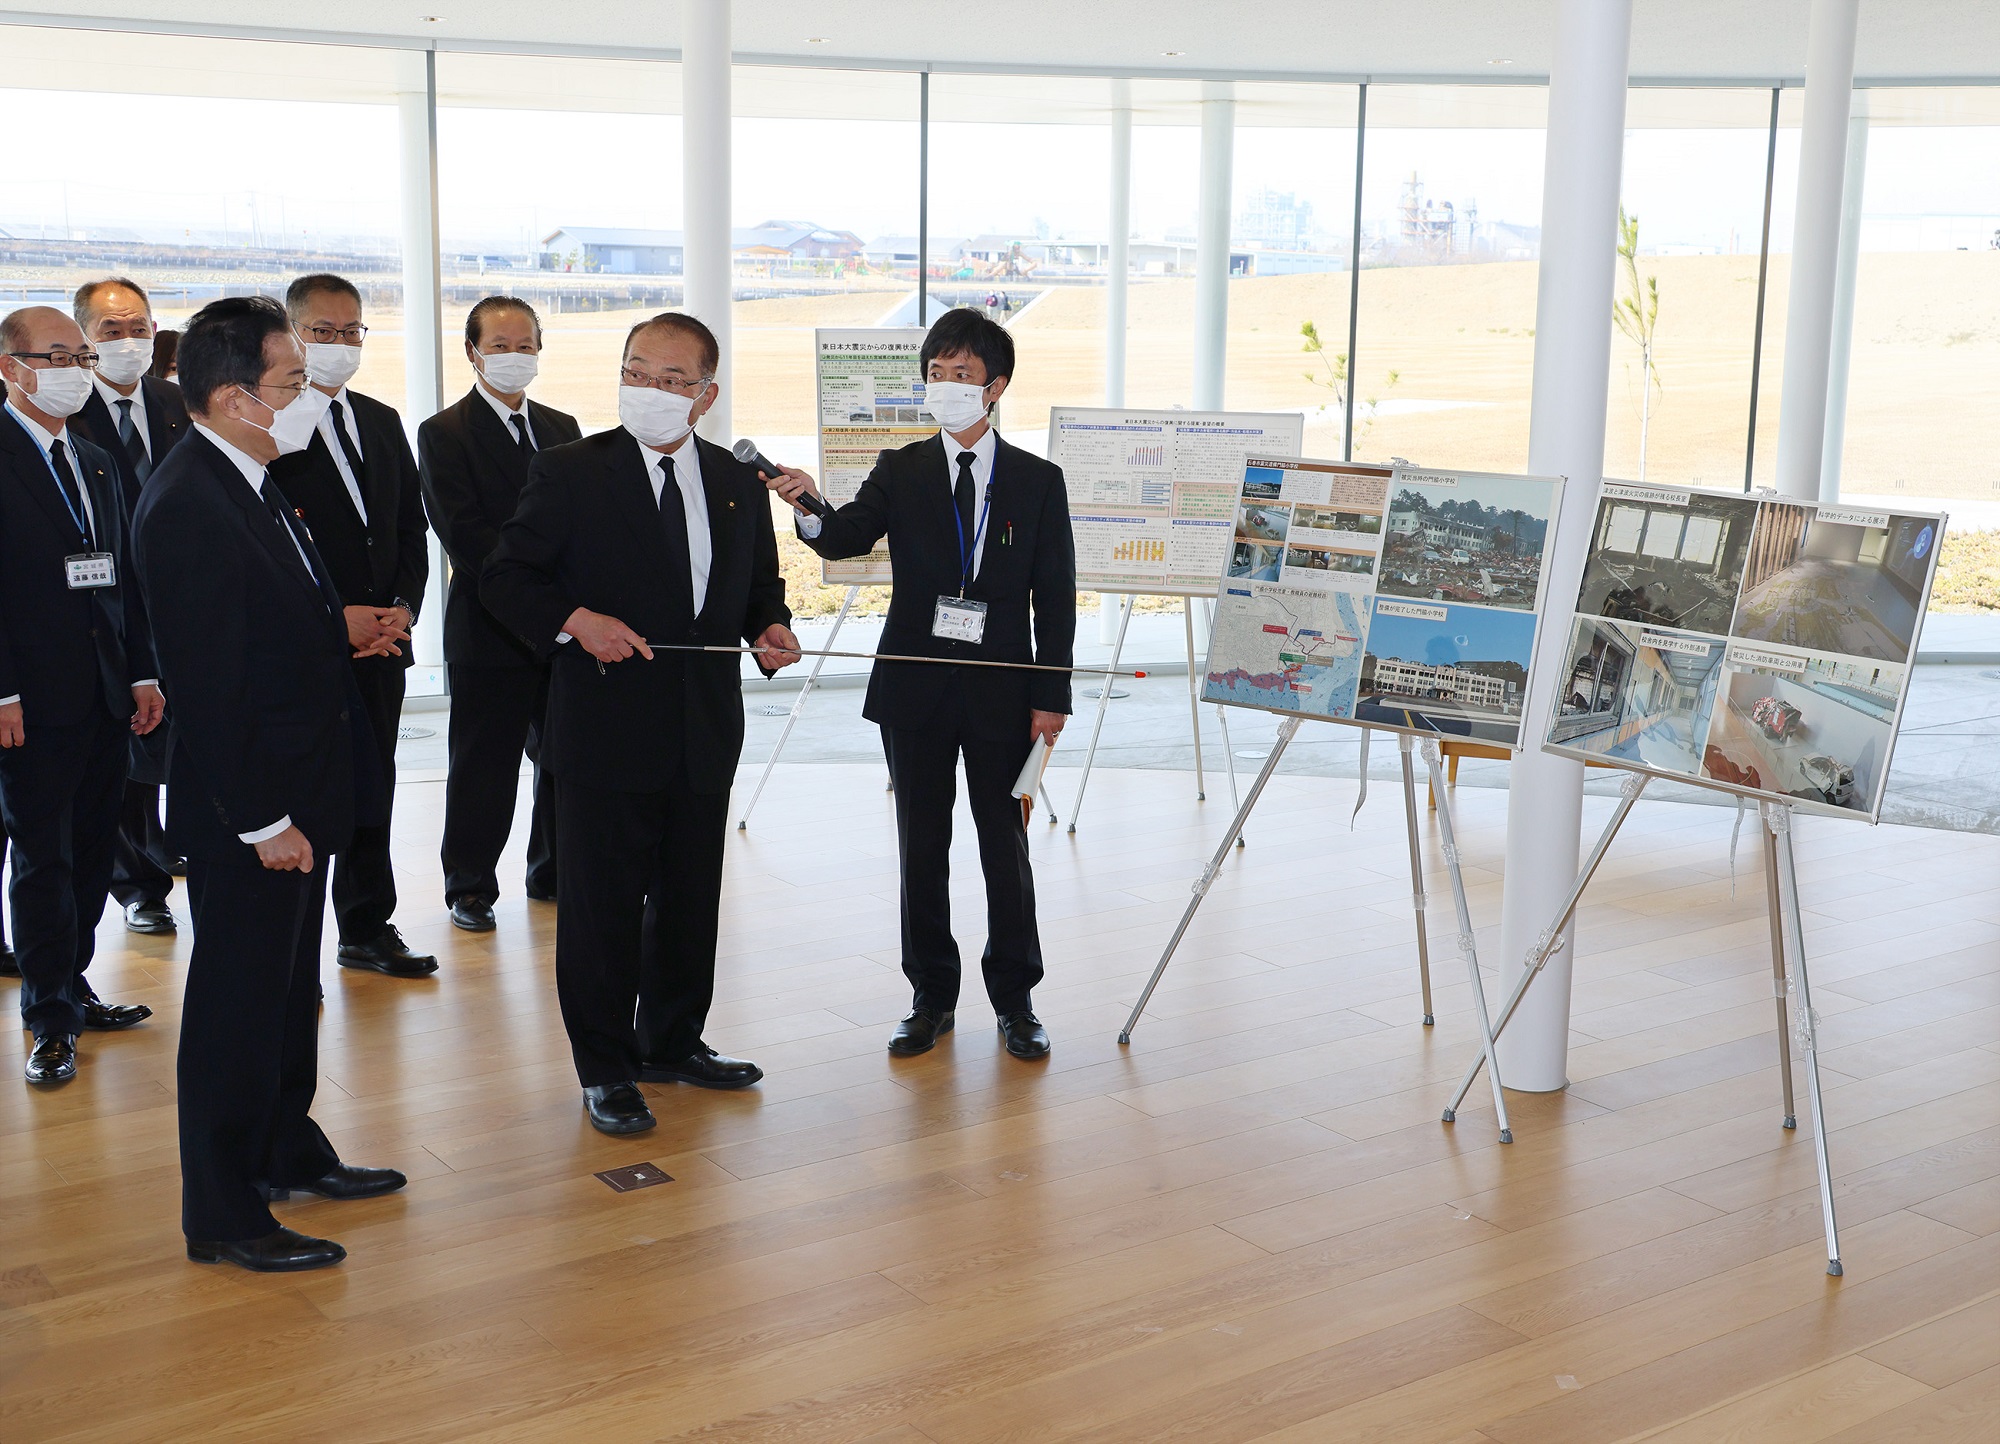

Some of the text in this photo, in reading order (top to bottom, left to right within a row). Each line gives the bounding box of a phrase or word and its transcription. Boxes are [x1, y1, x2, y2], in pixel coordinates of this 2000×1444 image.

[1818, 511, 1885, 525] 科学的データによる展示
[1379, 604, 1444, 618] 整備が完了した門脇小学校
[1641, 636, 1707, 653] 校舎内を見学する外部通路
[1733, 651, 1803, 669] 被災した消防車両と公用車
